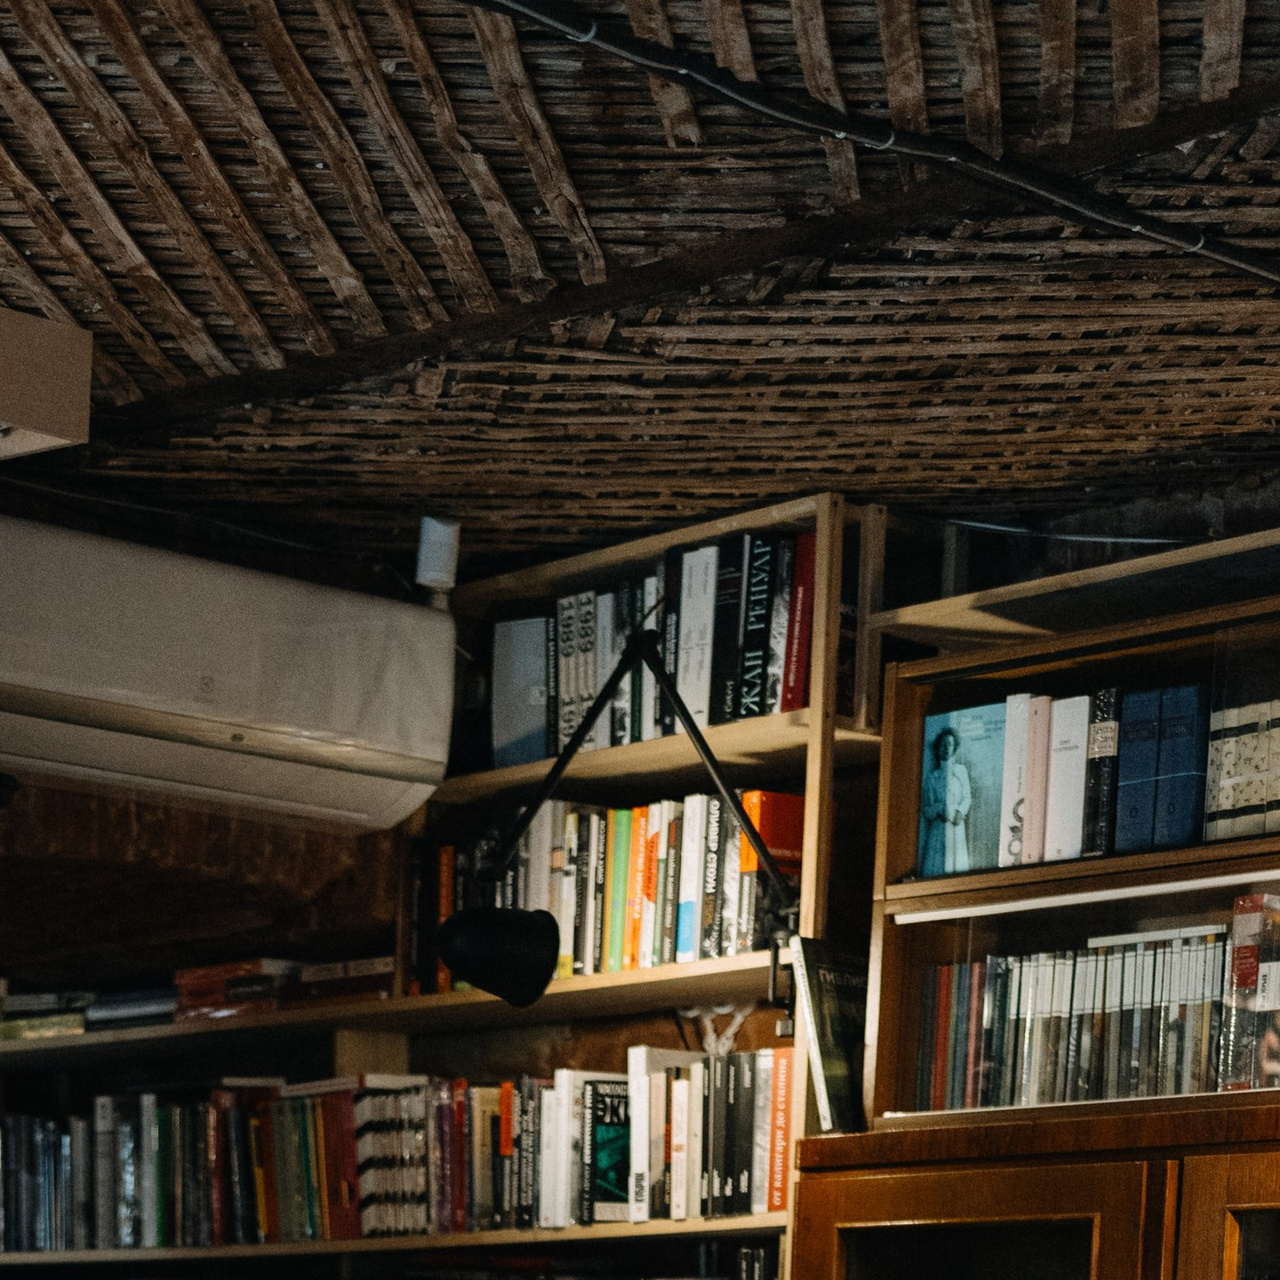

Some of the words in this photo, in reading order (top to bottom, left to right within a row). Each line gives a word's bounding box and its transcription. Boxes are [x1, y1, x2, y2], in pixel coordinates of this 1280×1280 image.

[747, 540, 771, 631] РЕНУАР
[740, 651, 764, 715] ЖАН
[707, 799, 720, 852] ОЛИВЕР
[705, 853, 718, 894] СТОУН
[777, 1058, 788, 1109] сталина
[777, 1111, 787, 1128] до
[773, 1130, 787, 1188] калигари
[772, 1190, 782, 1206] от
